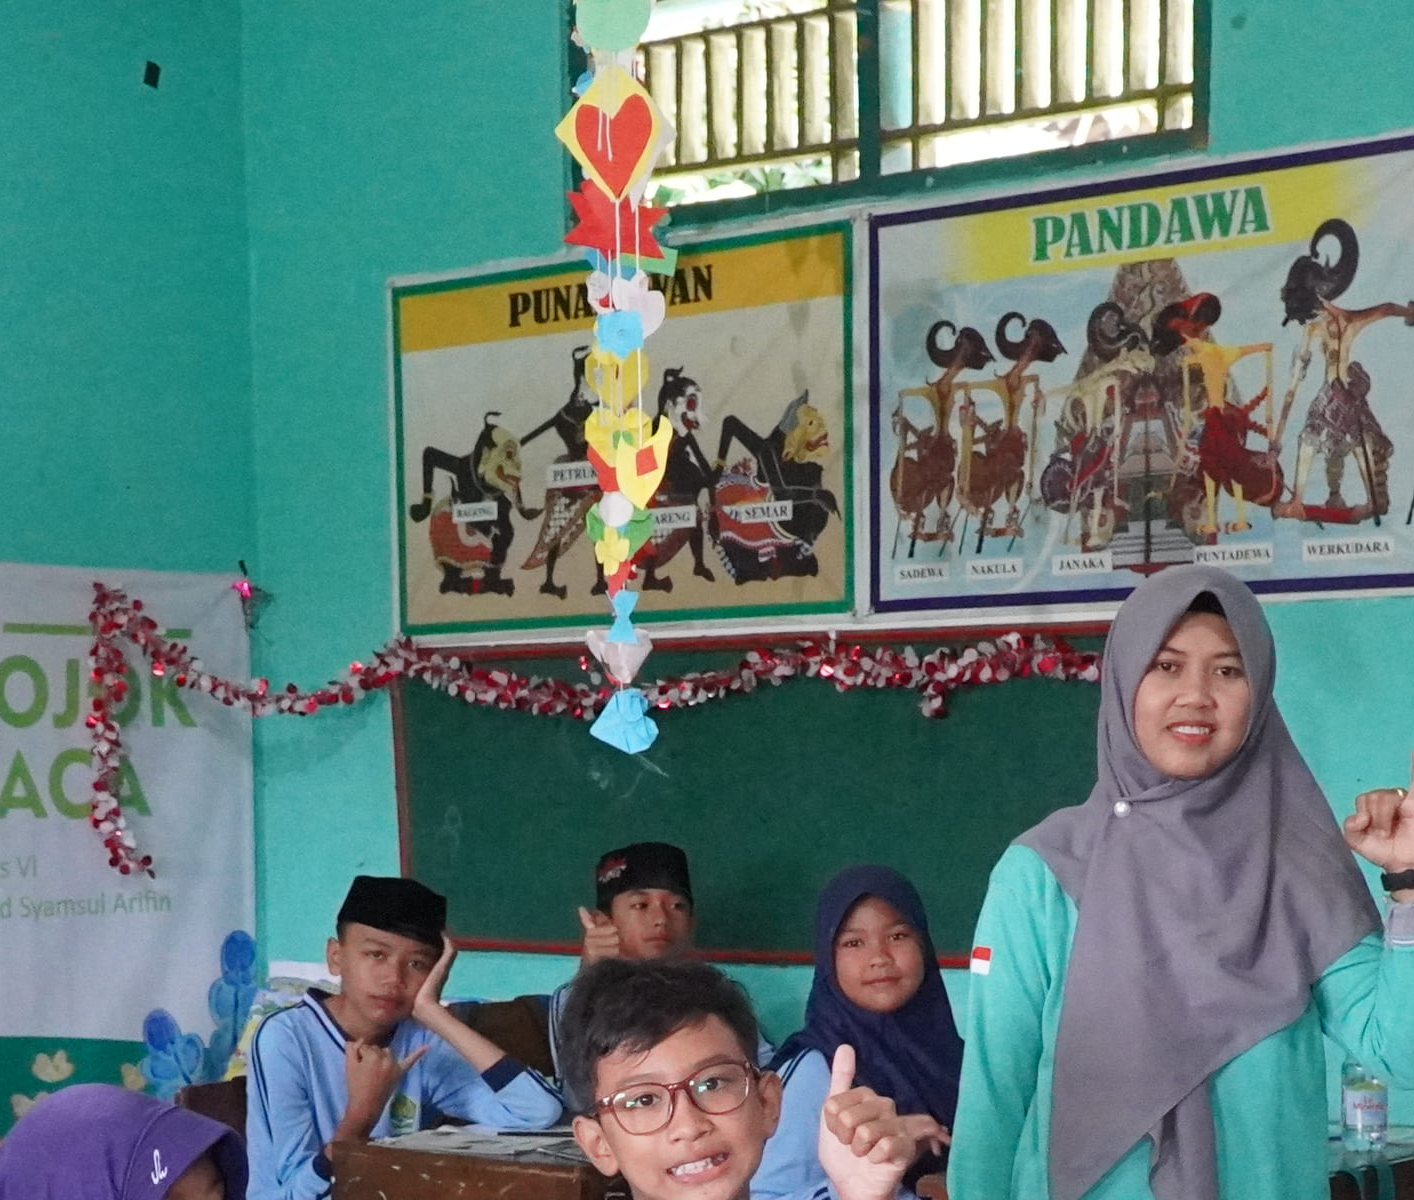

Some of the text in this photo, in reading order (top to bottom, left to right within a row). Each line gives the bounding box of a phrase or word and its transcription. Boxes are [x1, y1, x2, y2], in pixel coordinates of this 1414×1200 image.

[1033, 186, 1270, 262] PANDAWA
[653, 511, 692, 525] ARENG
[744, 504, 789, 518] SEMAR
[1195, 547, 1272, 563] PUNTADEWA
[1306, 541, 1391, 557] WERKUDARA
[970, 563, 1018, 576] NAKULA
[1058, 557, 1105, 571] JANAKA
[898, 566, 945, 580] SADEWA
[19, 891, 106, 924] Syamsul
[112, 889, 172, 914] Arifin
